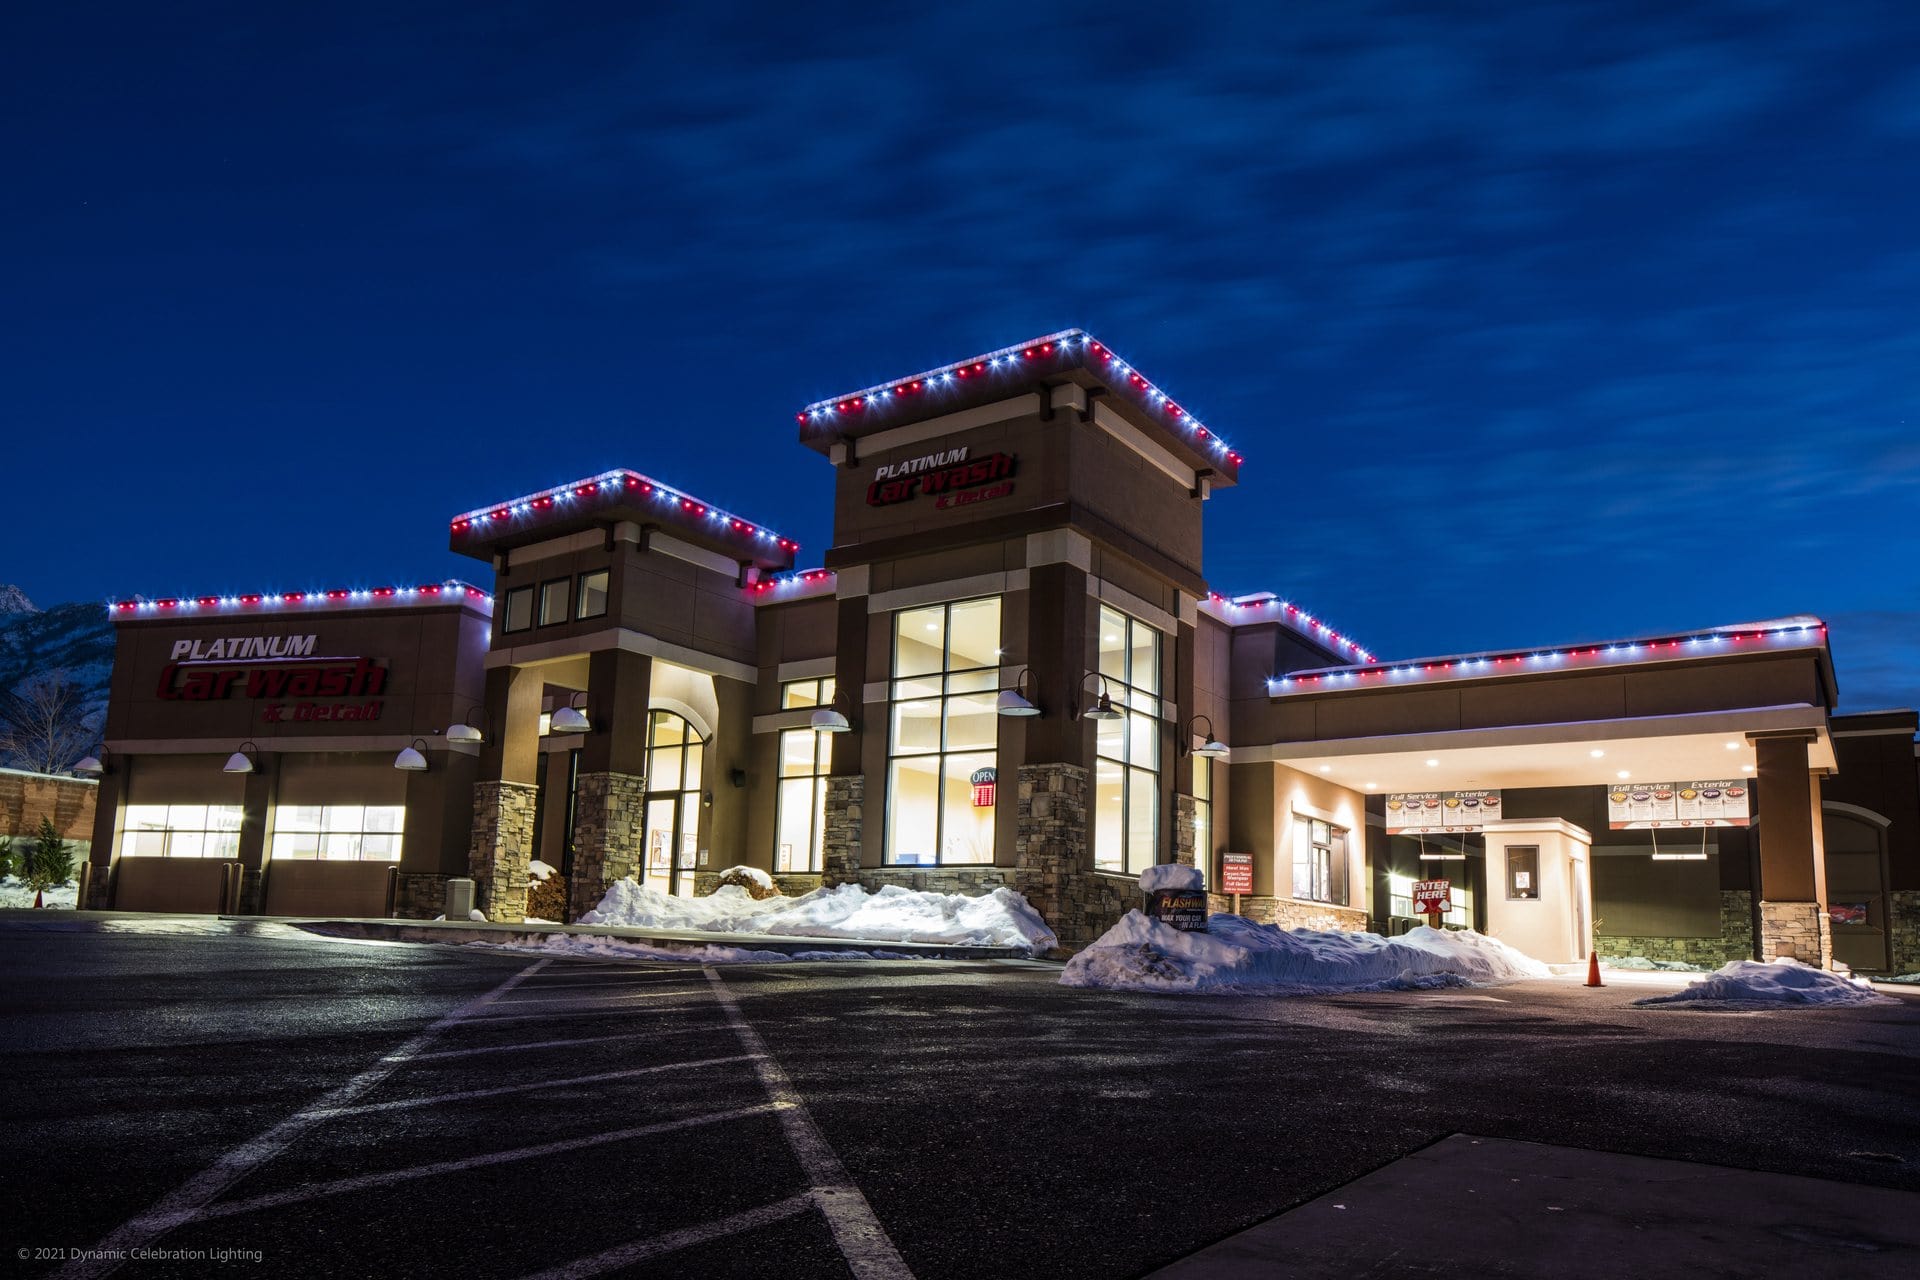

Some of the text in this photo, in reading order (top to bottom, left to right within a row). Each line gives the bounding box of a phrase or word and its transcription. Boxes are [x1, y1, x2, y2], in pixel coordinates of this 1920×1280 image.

[874, 446, 968, 481] PLATINUM
[170, 634, 318, 660] PLATINUM
[972, 771, 995, 783] OPEN
[1613, 783, 1671, 792] Full Service
[1691, 781, 1733, 789] Exterior
[1414, 881, 1449, 890] ENTER
[1417, 890, 1447, 899] HERE
[1175, 914, 1191, 922] YOUR
